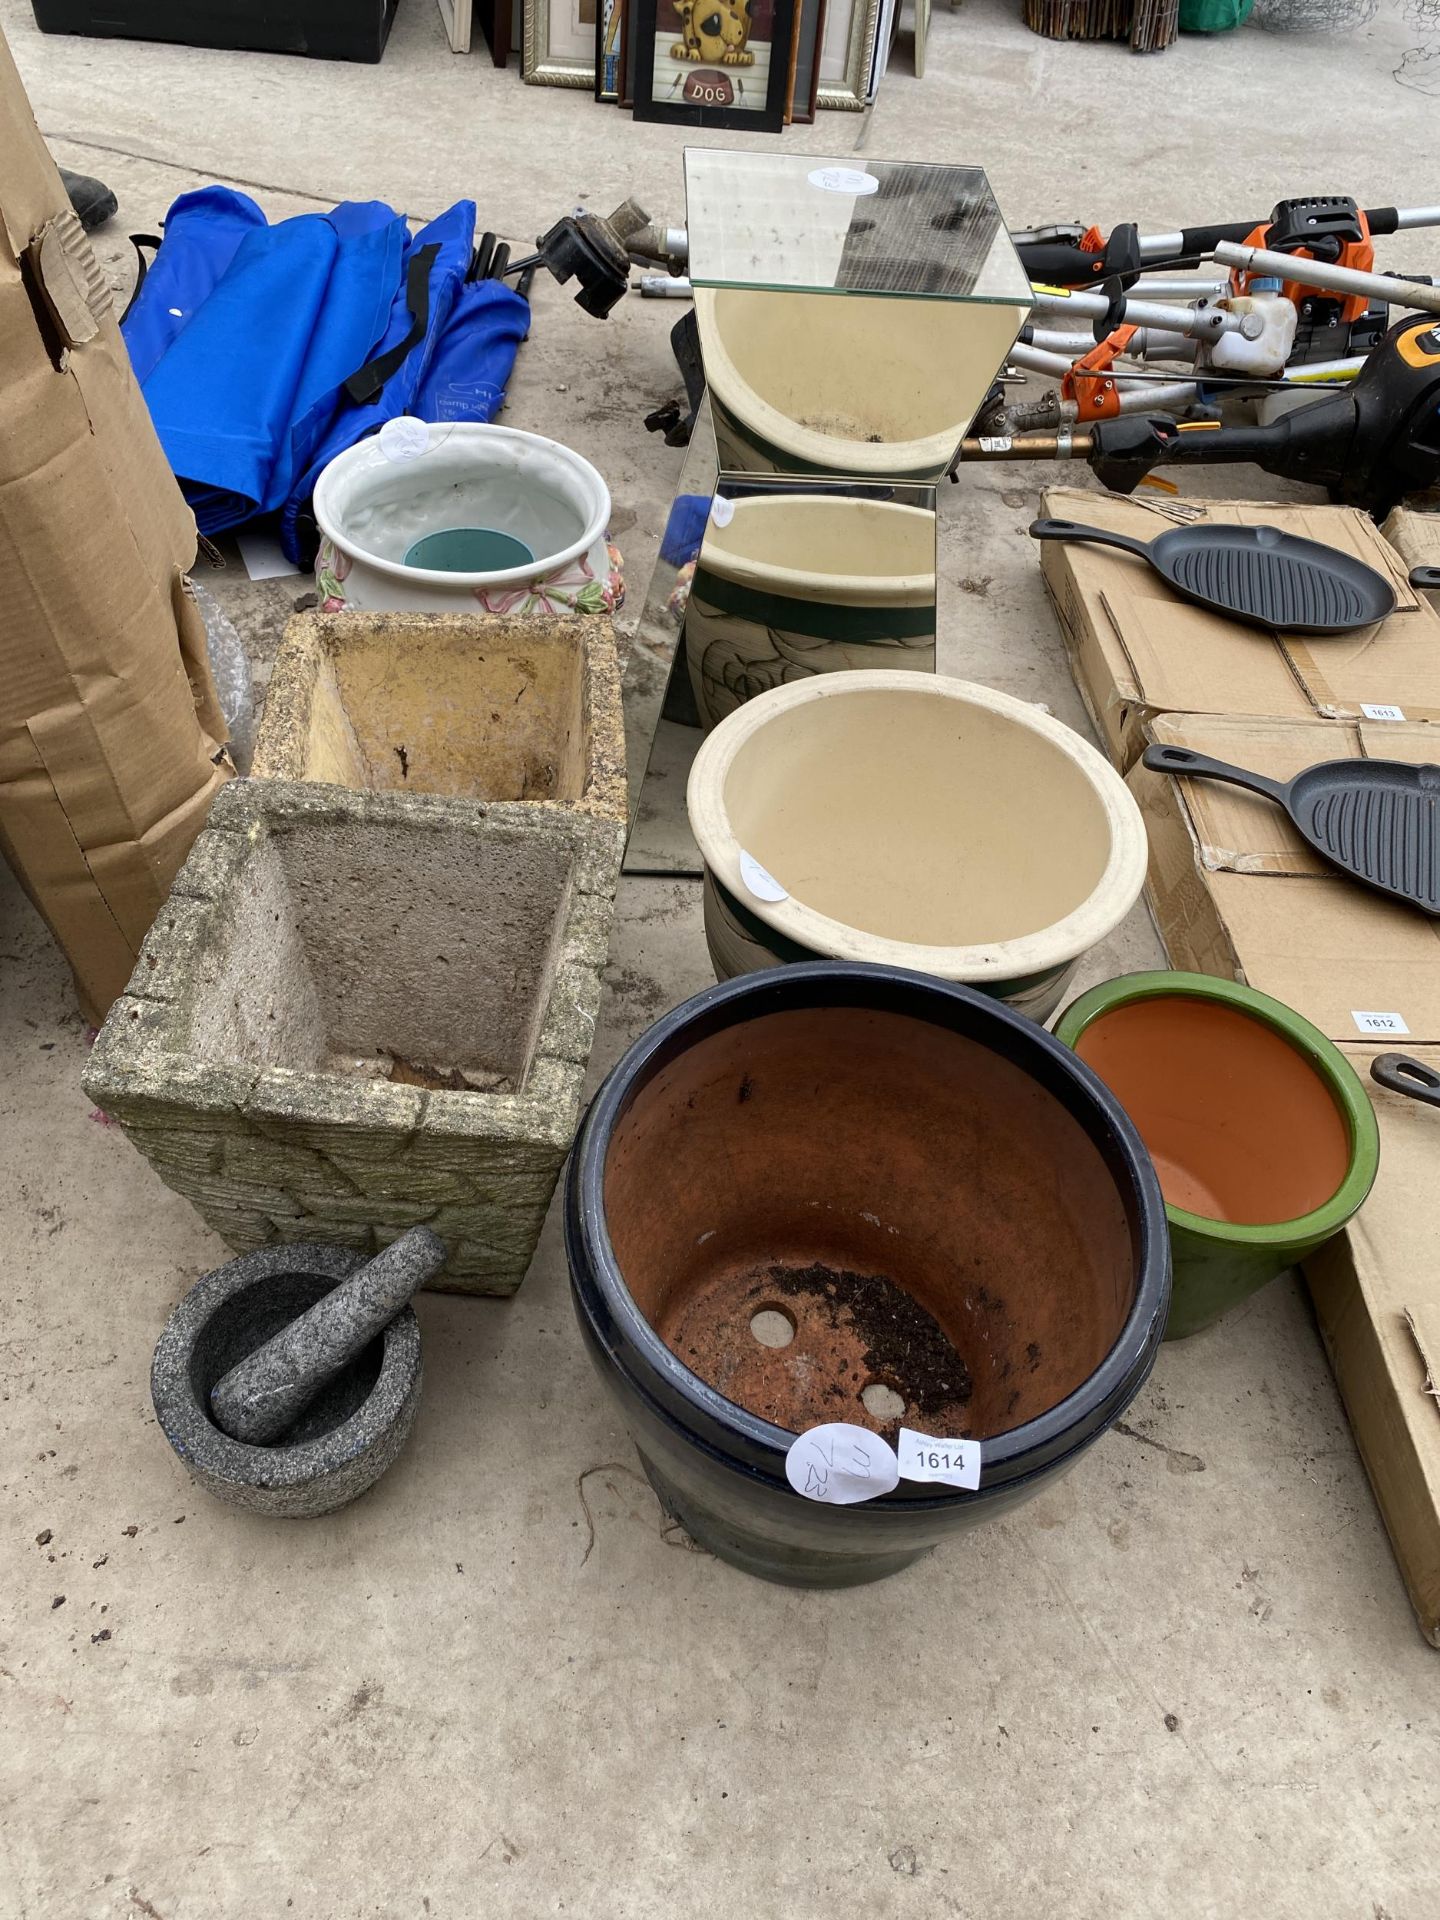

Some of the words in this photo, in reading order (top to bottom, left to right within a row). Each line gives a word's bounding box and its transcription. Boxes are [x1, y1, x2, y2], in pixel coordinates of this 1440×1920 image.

[691, 85, 726, 102] DOG
[1372, 709, 1396, 718] 1613
[1365, 1018, 1396, 1028] 1612
[916, 1450, 965, 1470] 1614
